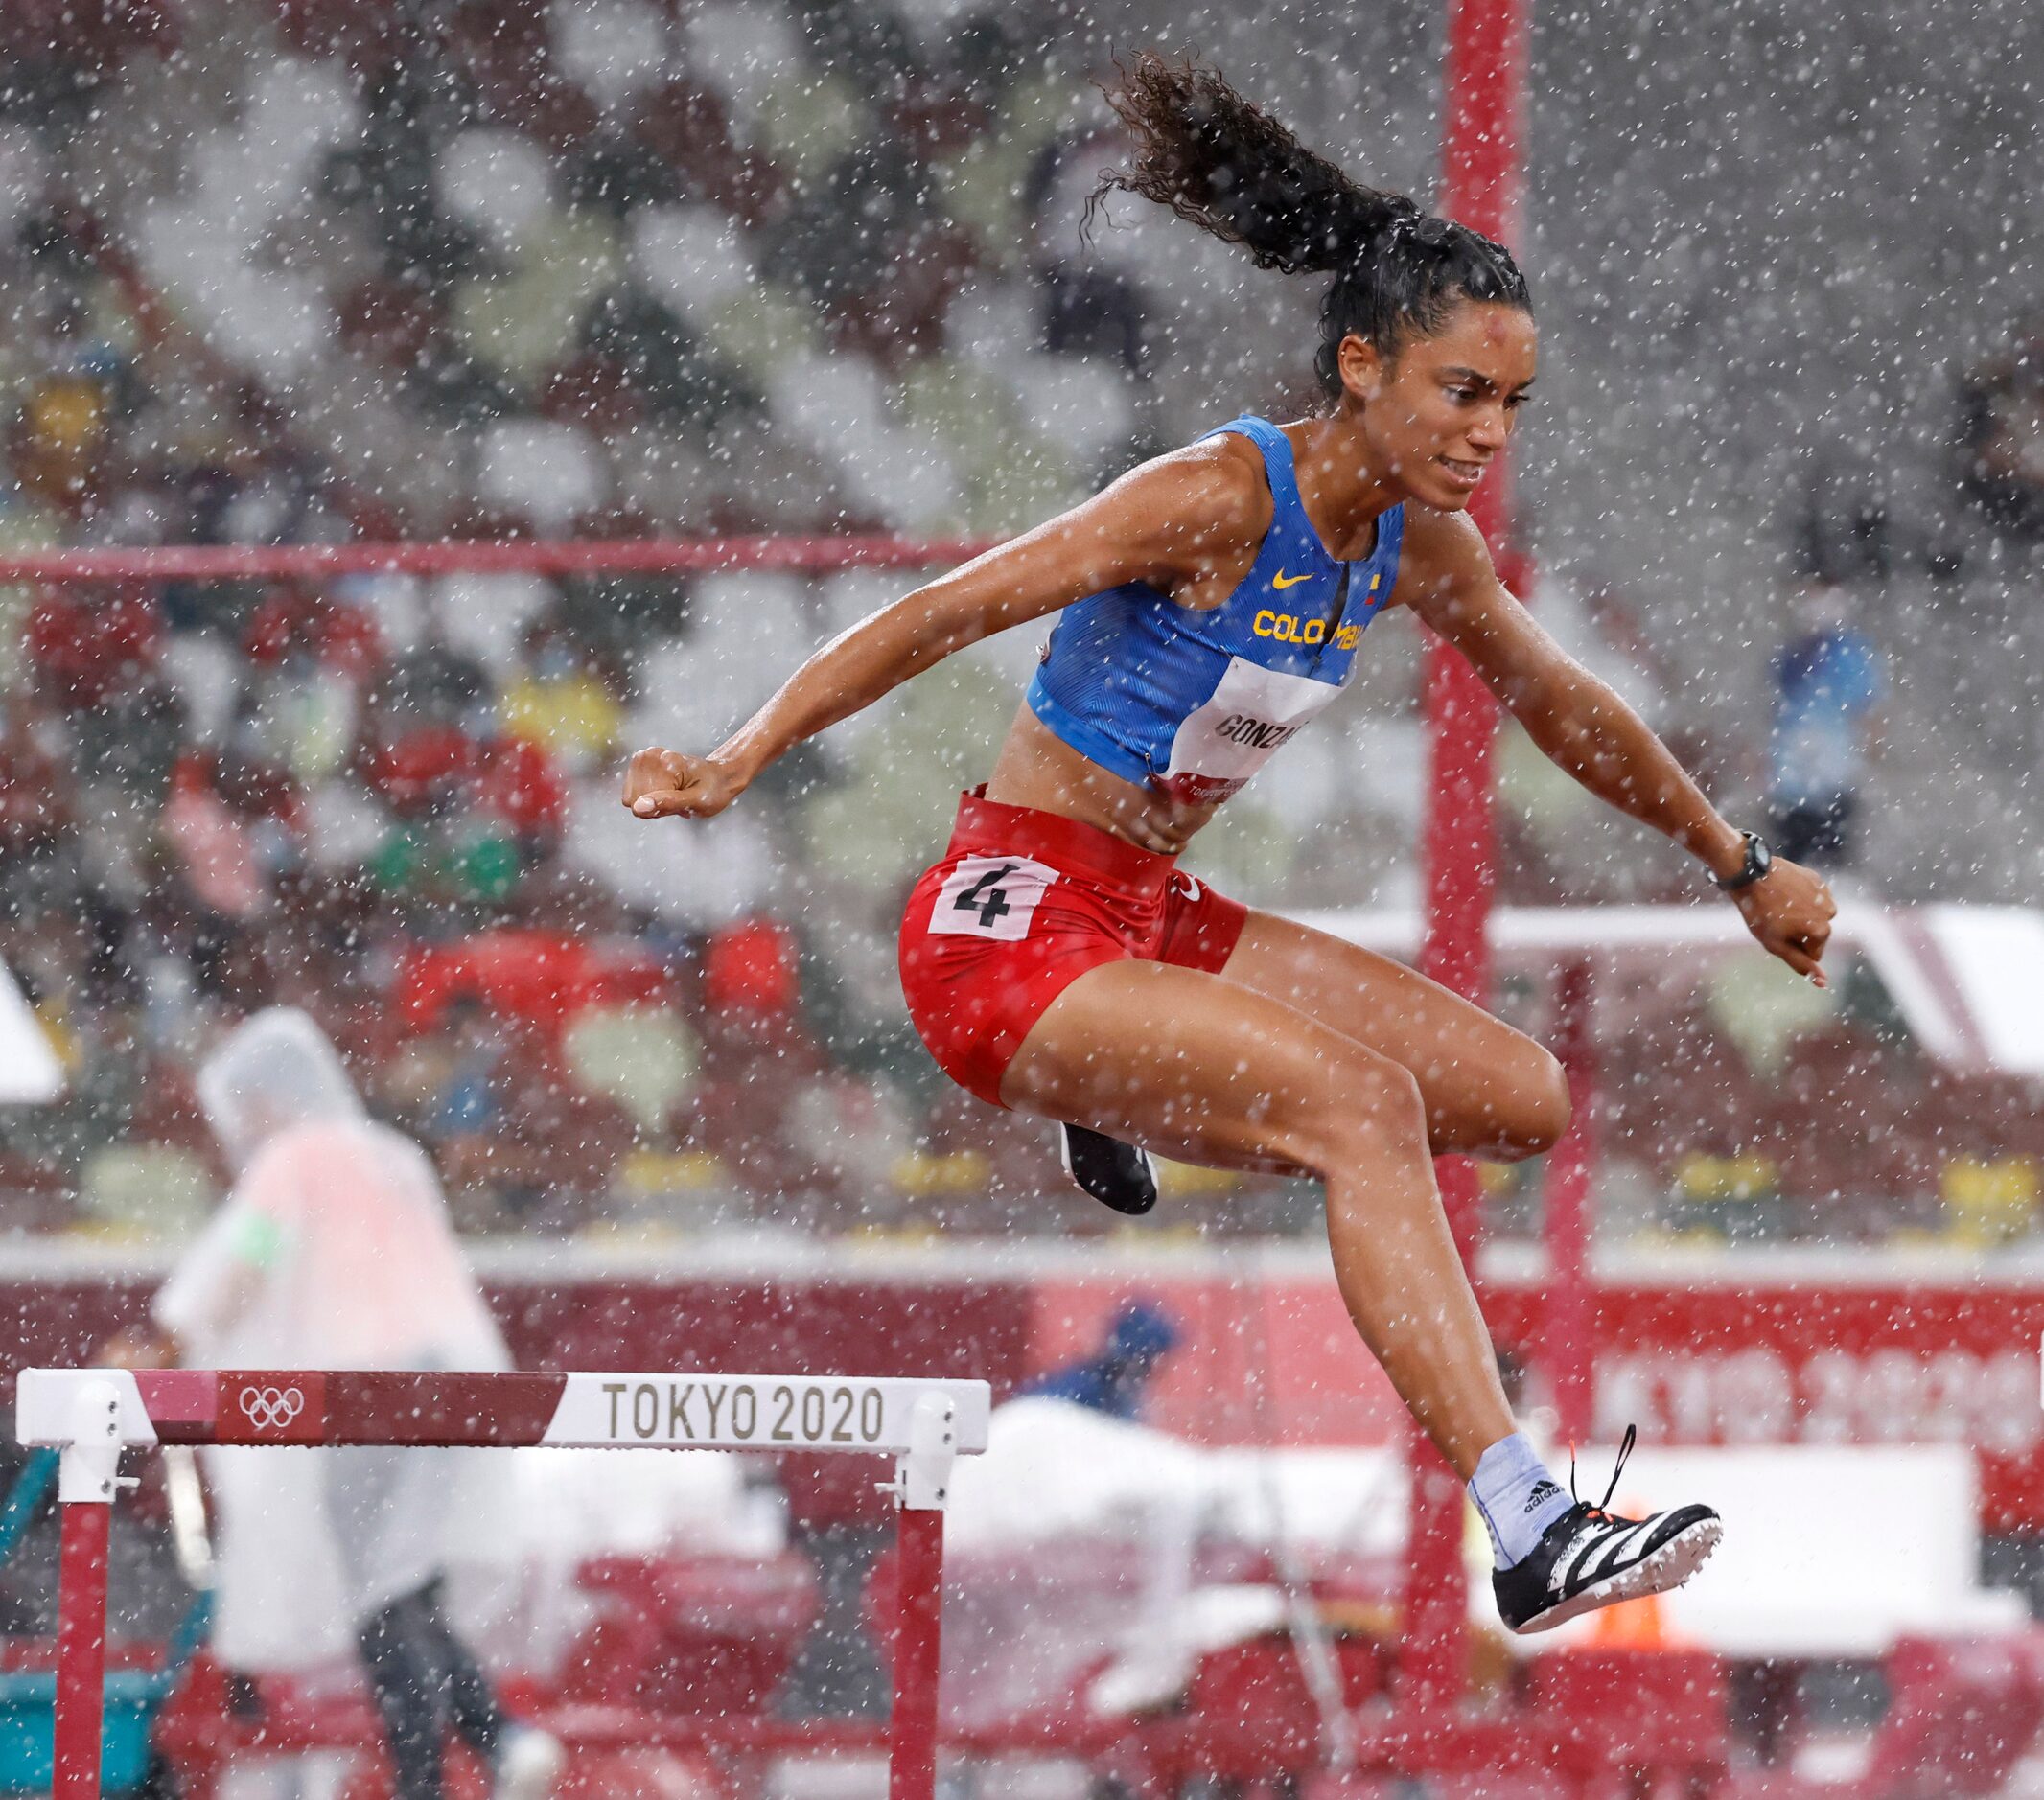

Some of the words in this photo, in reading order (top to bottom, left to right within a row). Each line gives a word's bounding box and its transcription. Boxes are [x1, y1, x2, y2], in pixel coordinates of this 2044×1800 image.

[953, 864, 1021, 928] 4
[602, 1383, 756, 1439] TOKYO
[771, 1385, 883, 1442] 2020
